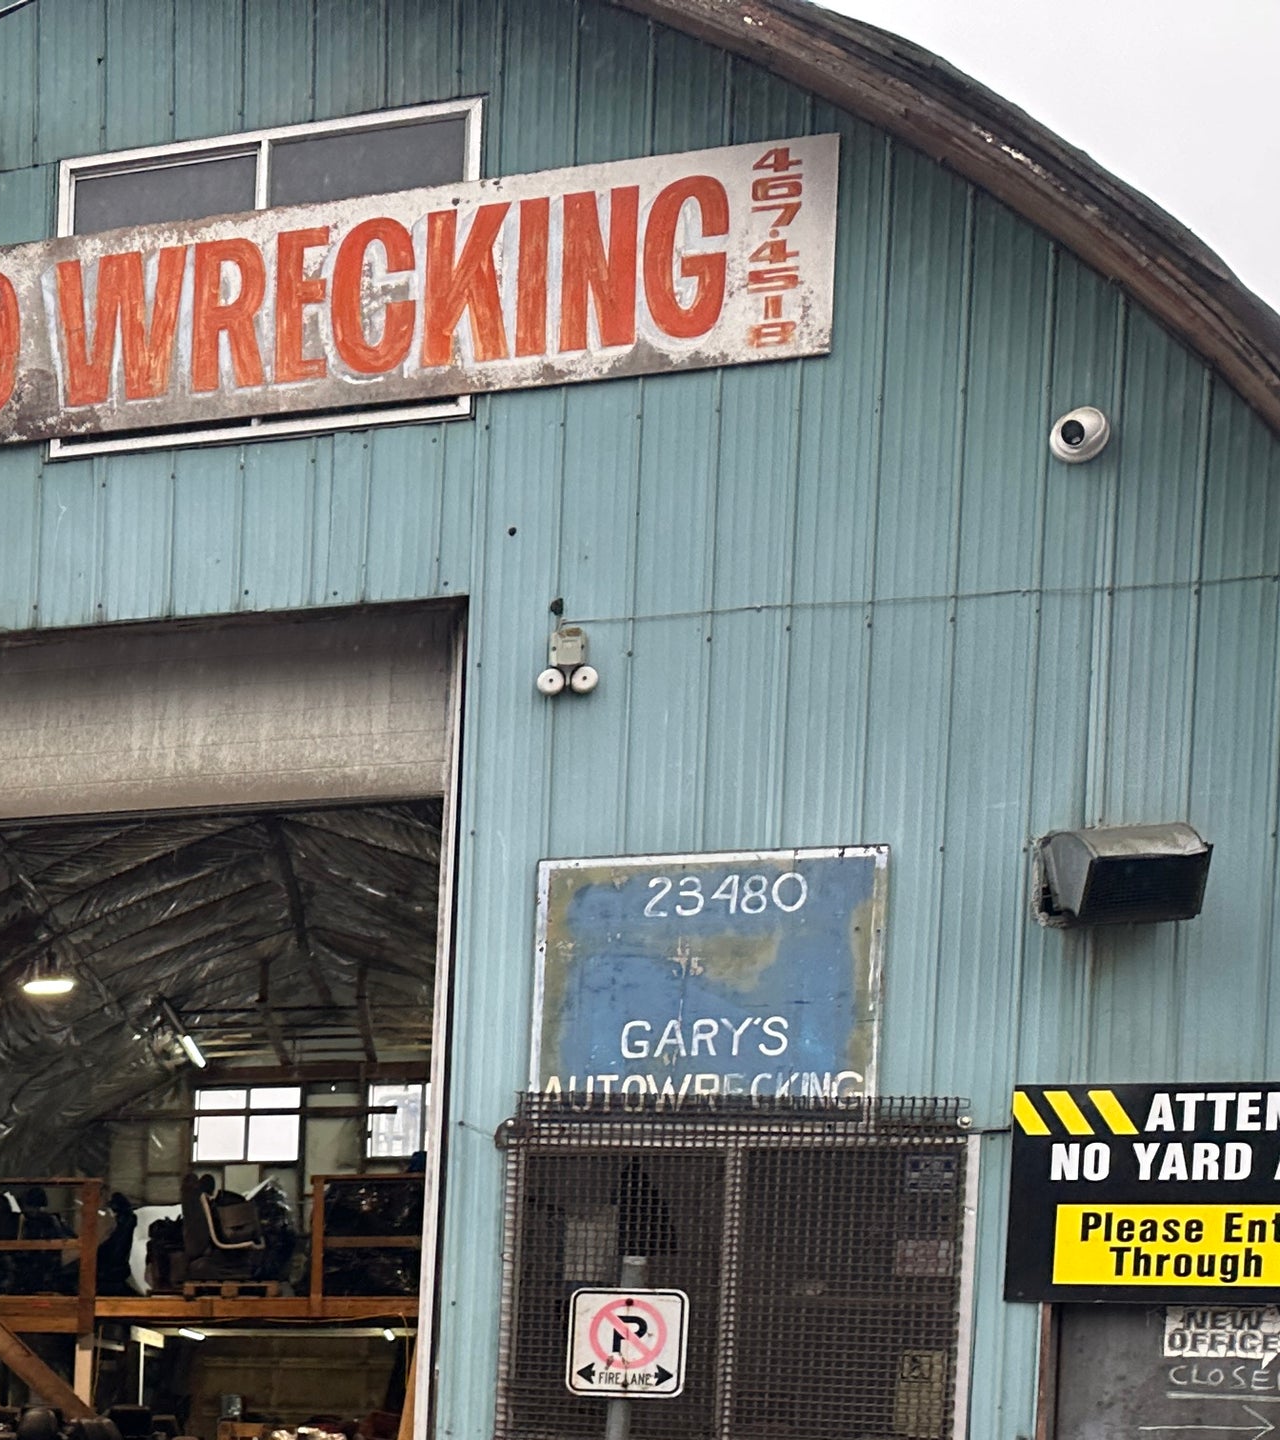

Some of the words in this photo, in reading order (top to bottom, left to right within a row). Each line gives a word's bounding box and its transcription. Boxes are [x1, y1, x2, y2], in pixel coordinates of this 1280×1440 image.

[56, 174, 731, 408] WRECKING
[643, 871, 808, 918] 23480
[620, 1016, 789, 1059] GARY'S
[1050, 1142, 1111, 1181] NO
[1133, 1142, 1253, 1181] YARD
[1080, 1211, 1204, 1243] Please
[1109, 1246, 1263, 1283] Through
[1184, 1309, 1261, 1330] NEW
[598, 1371, 621, 1386] FIRE
[1168, 1364, 1280, 1391] CLOSE
